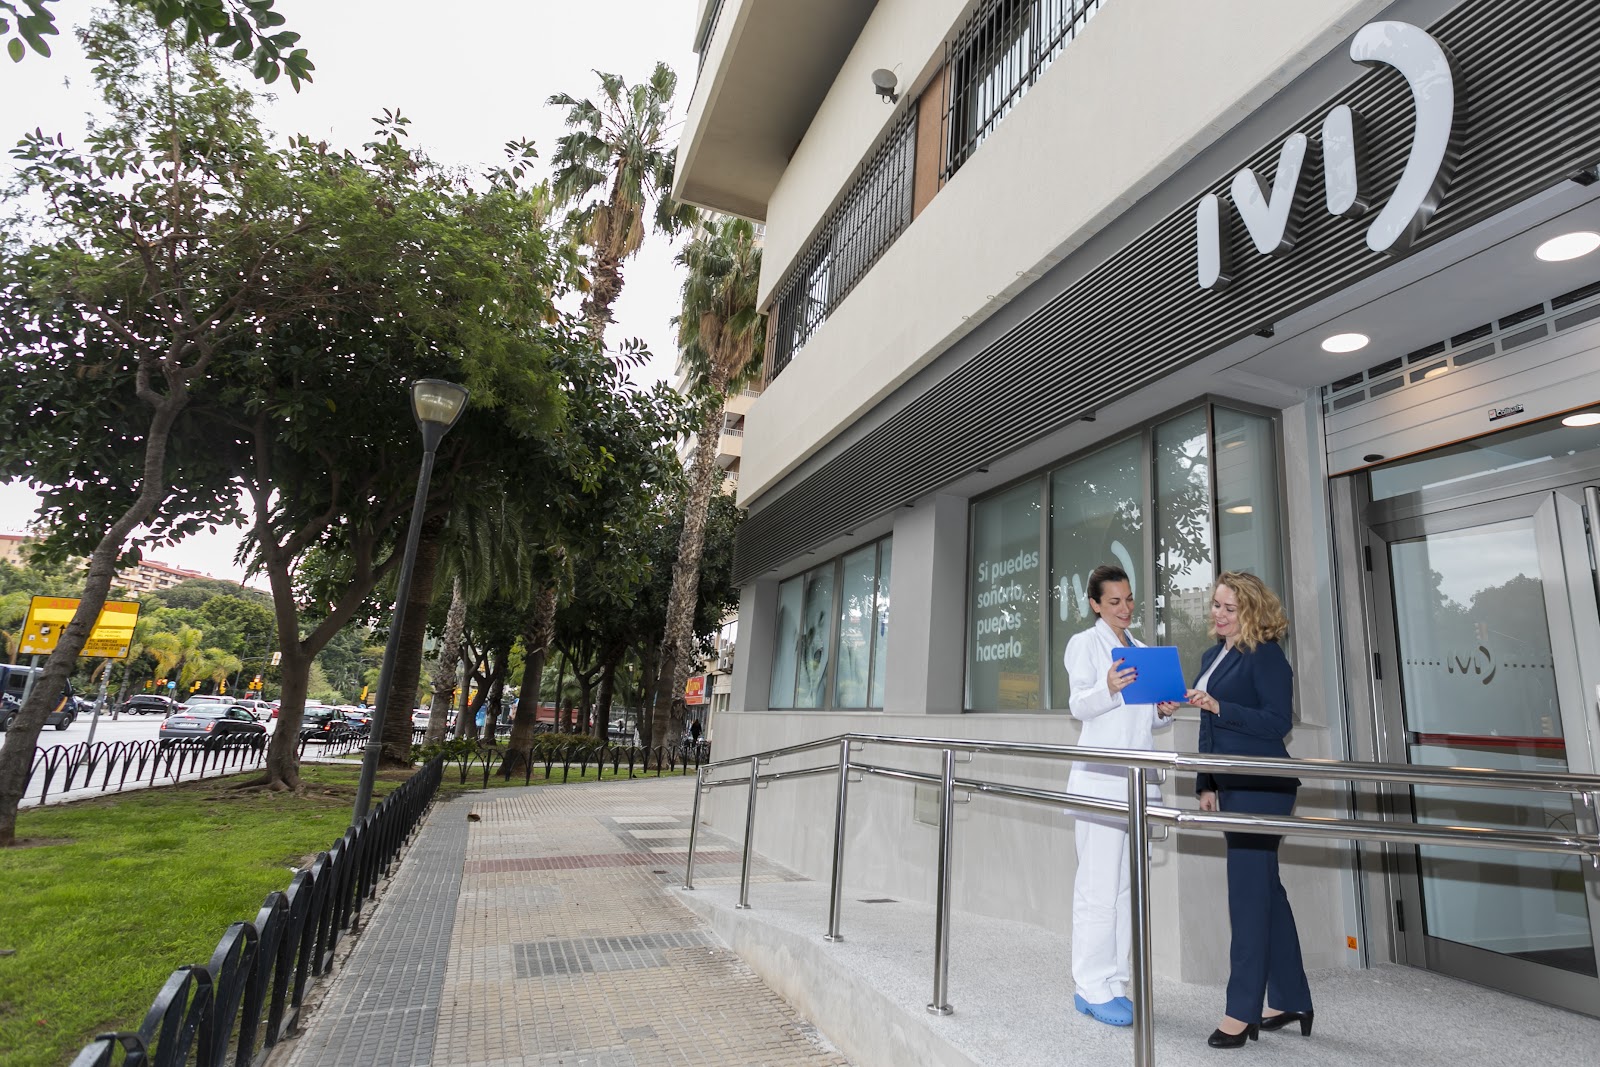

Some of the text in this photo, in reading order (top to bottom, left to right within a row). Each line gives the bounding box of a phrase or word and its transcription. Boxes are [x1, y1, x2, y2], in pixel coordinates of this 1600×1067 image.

[978, 550, 1039, 584] Si puedes
[977, 580, 1026, 608] soñarlo,
[977, 612, 1021, 640] puedes
[976, 636, 1021, 661] hacerlo
